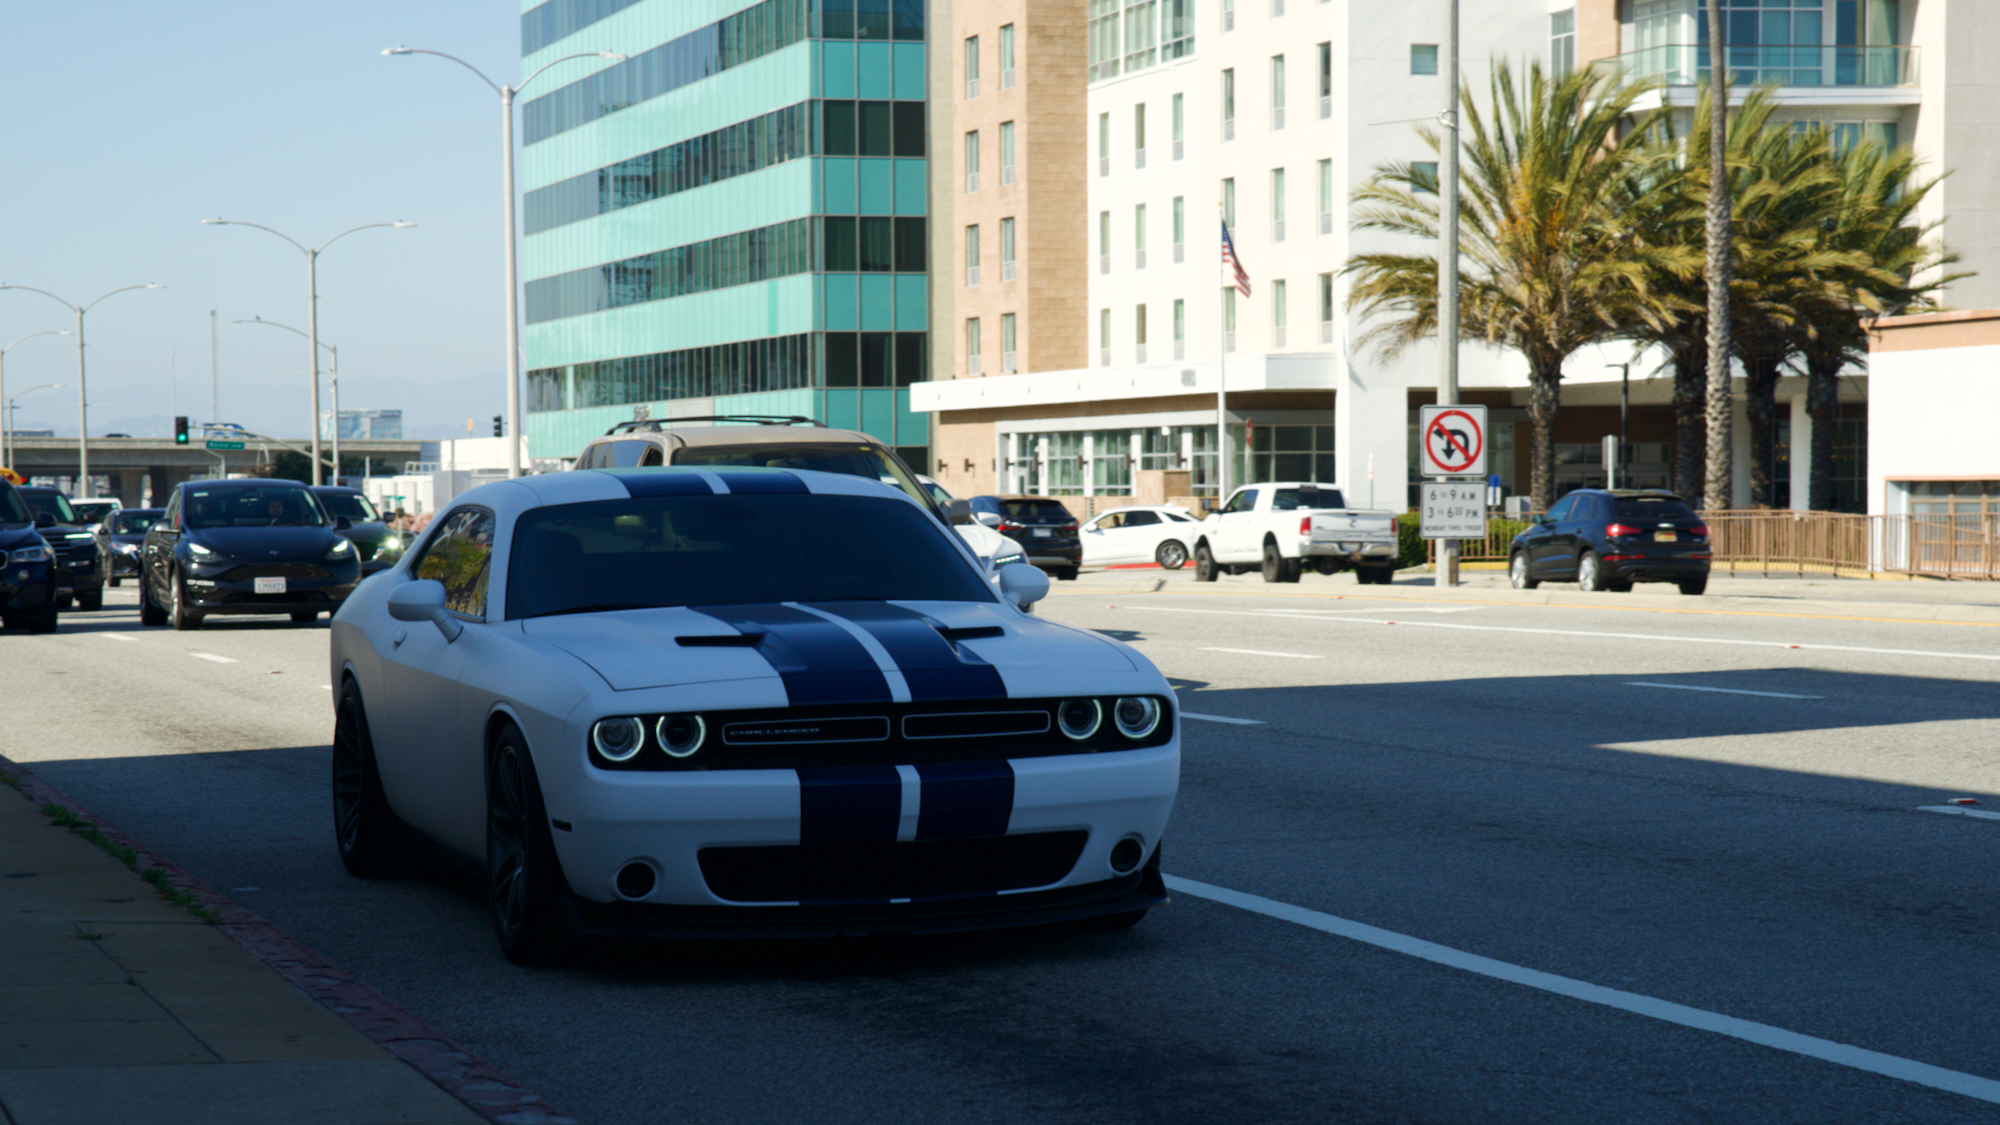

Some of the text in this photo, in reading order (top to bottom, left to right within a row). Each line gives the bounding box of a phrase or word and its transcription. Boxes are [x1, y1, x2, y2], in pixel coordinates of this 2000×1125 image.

[1430, 490, 1437, 501] 6
[1450, 489, 1456, 500] 9
[1428, 506, 1434, 518] 3
[730, 728, 820, 736] CHALLENGER
